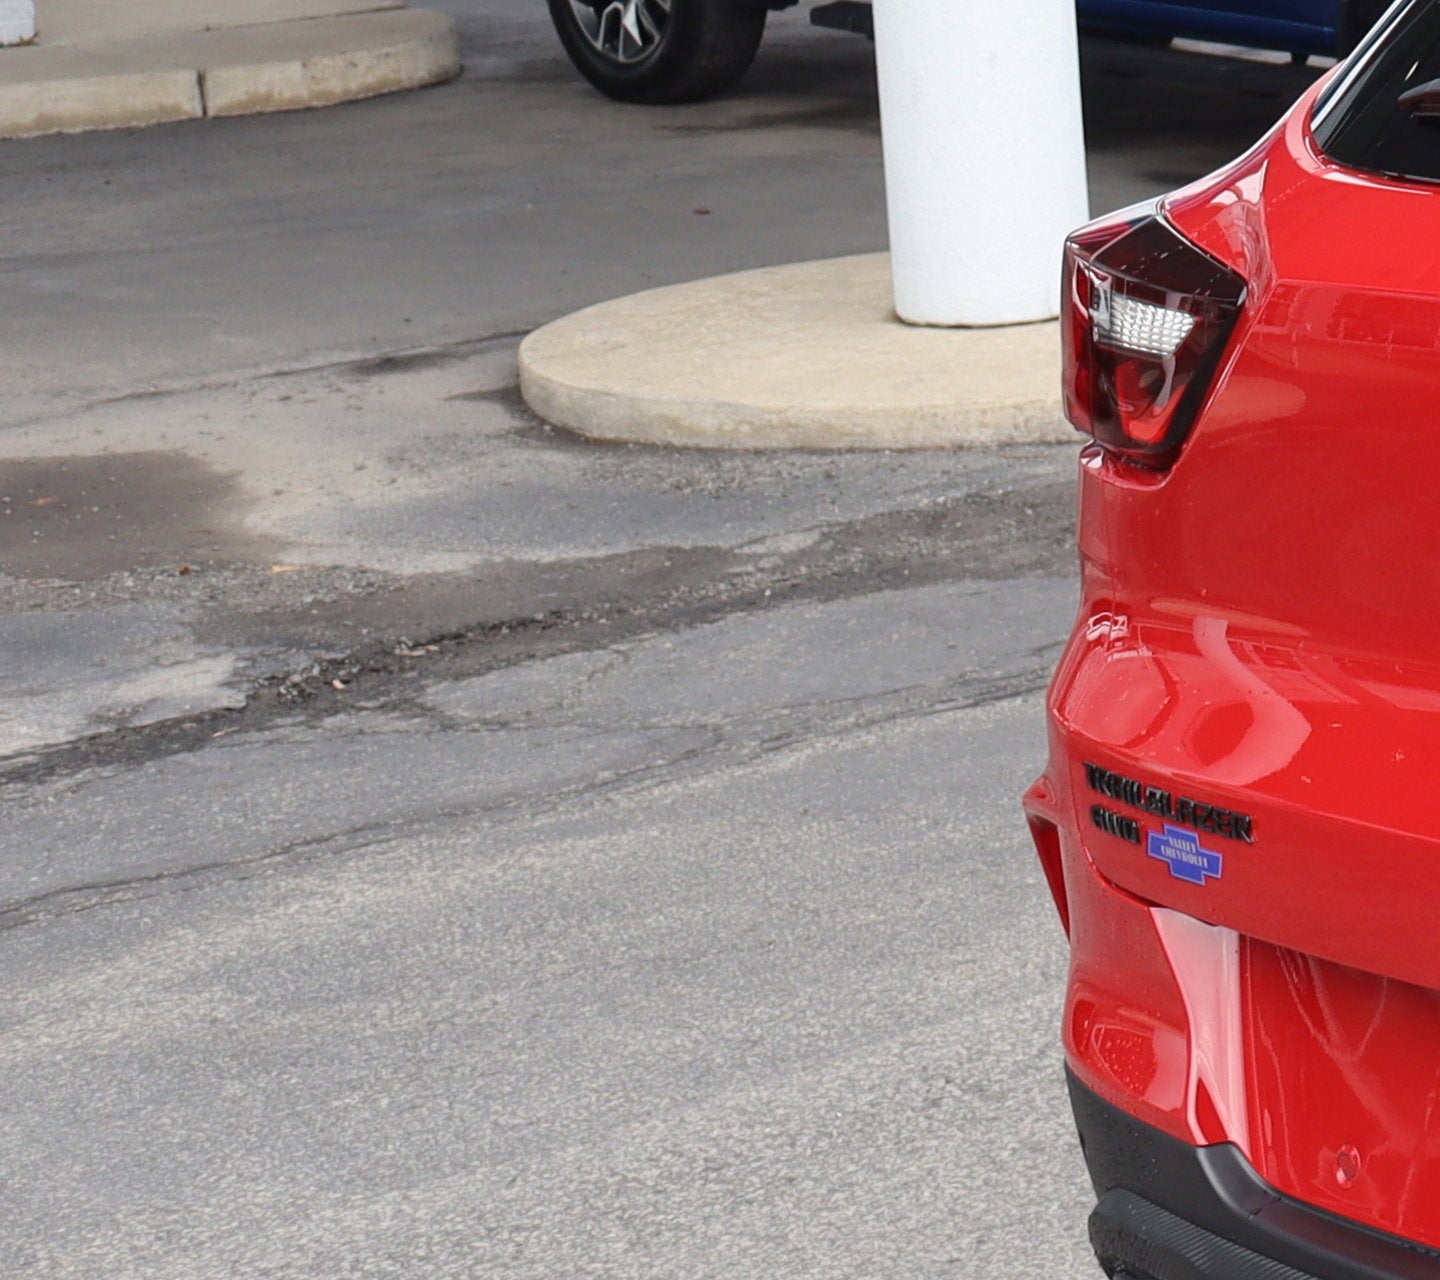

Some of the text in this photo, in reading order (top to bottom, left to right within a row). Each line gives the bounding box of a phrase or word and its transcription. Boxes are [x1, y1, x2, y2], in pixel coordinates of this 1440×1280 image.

[1082, 760, 1256, 844] TRAILBLAZER
[1160, 844, 1209, 869] CHEVROLET
[1168, 835, 1197, 853] VALLEY
